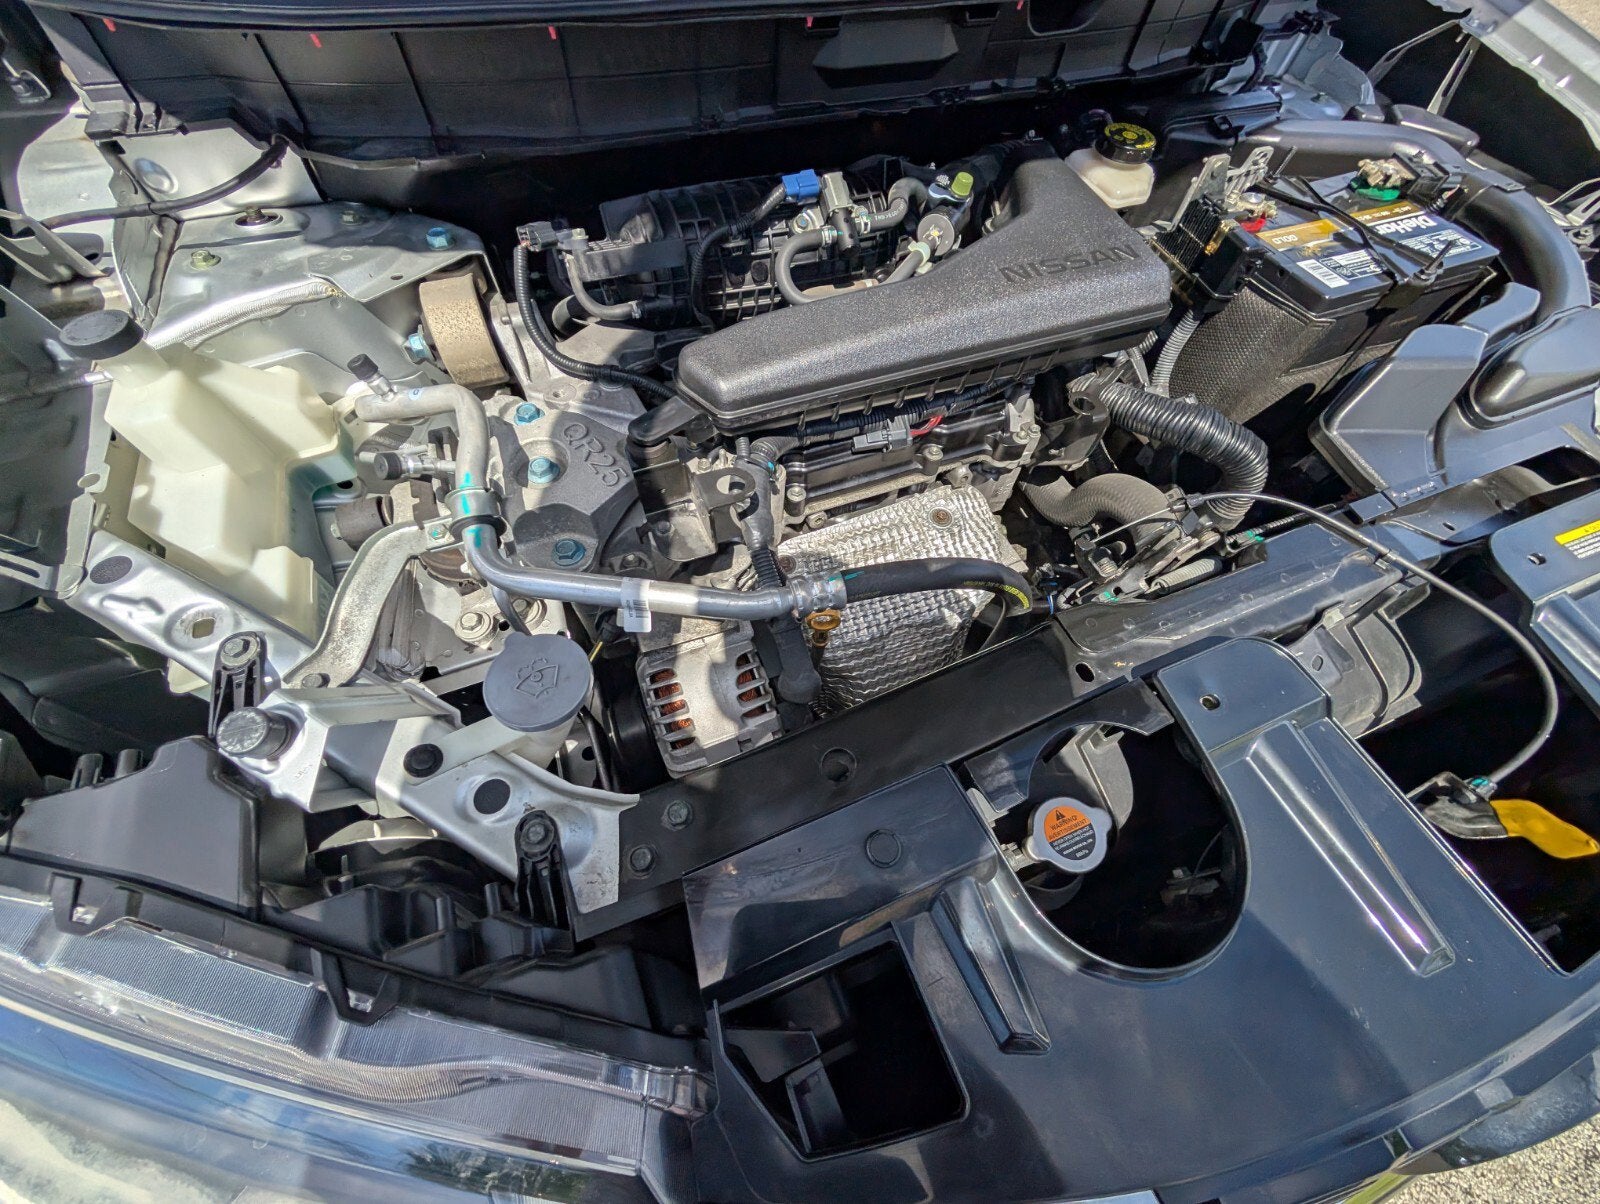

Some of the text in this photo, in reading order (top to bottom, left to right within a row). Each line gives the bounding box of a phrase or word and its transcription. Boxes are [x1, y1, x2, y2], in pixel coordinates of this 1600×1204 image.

[1374, 214, 1438, 235] DieHar
[1272, 234, 1298, 245] GOLD
[999, 244, 1140, 283] NISSAN
[563, 422, 629, 487] QR25
[1050, 815, 1078, 831] WARNING
